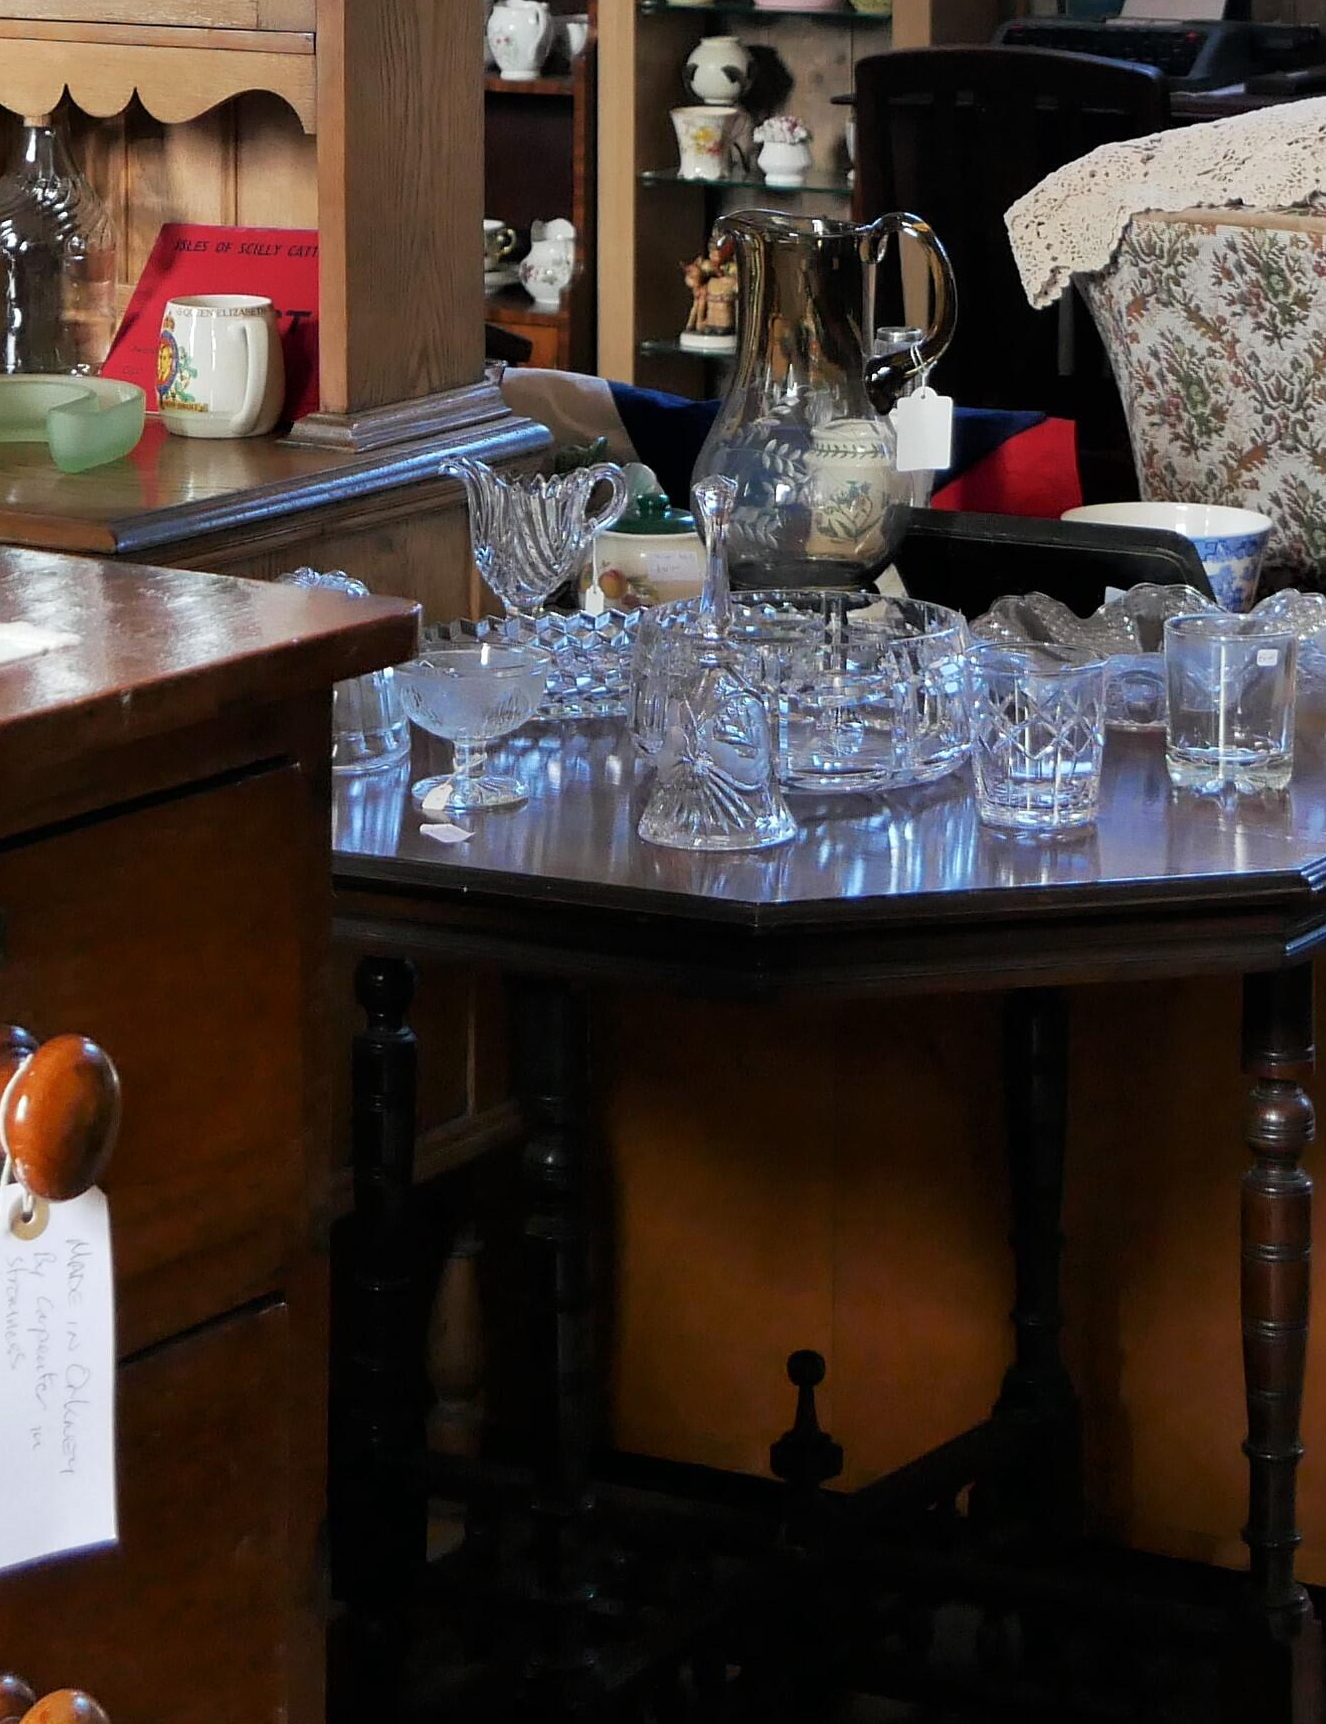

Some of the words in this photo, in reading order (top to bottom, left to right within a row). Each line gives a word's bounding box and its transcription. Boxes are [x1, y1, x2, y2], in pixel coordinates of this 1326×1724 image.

[174, 238, 210, 252] ISLES
[215, 241, 233, 254] OF
[237, 243, 283, 256] SCILLY
